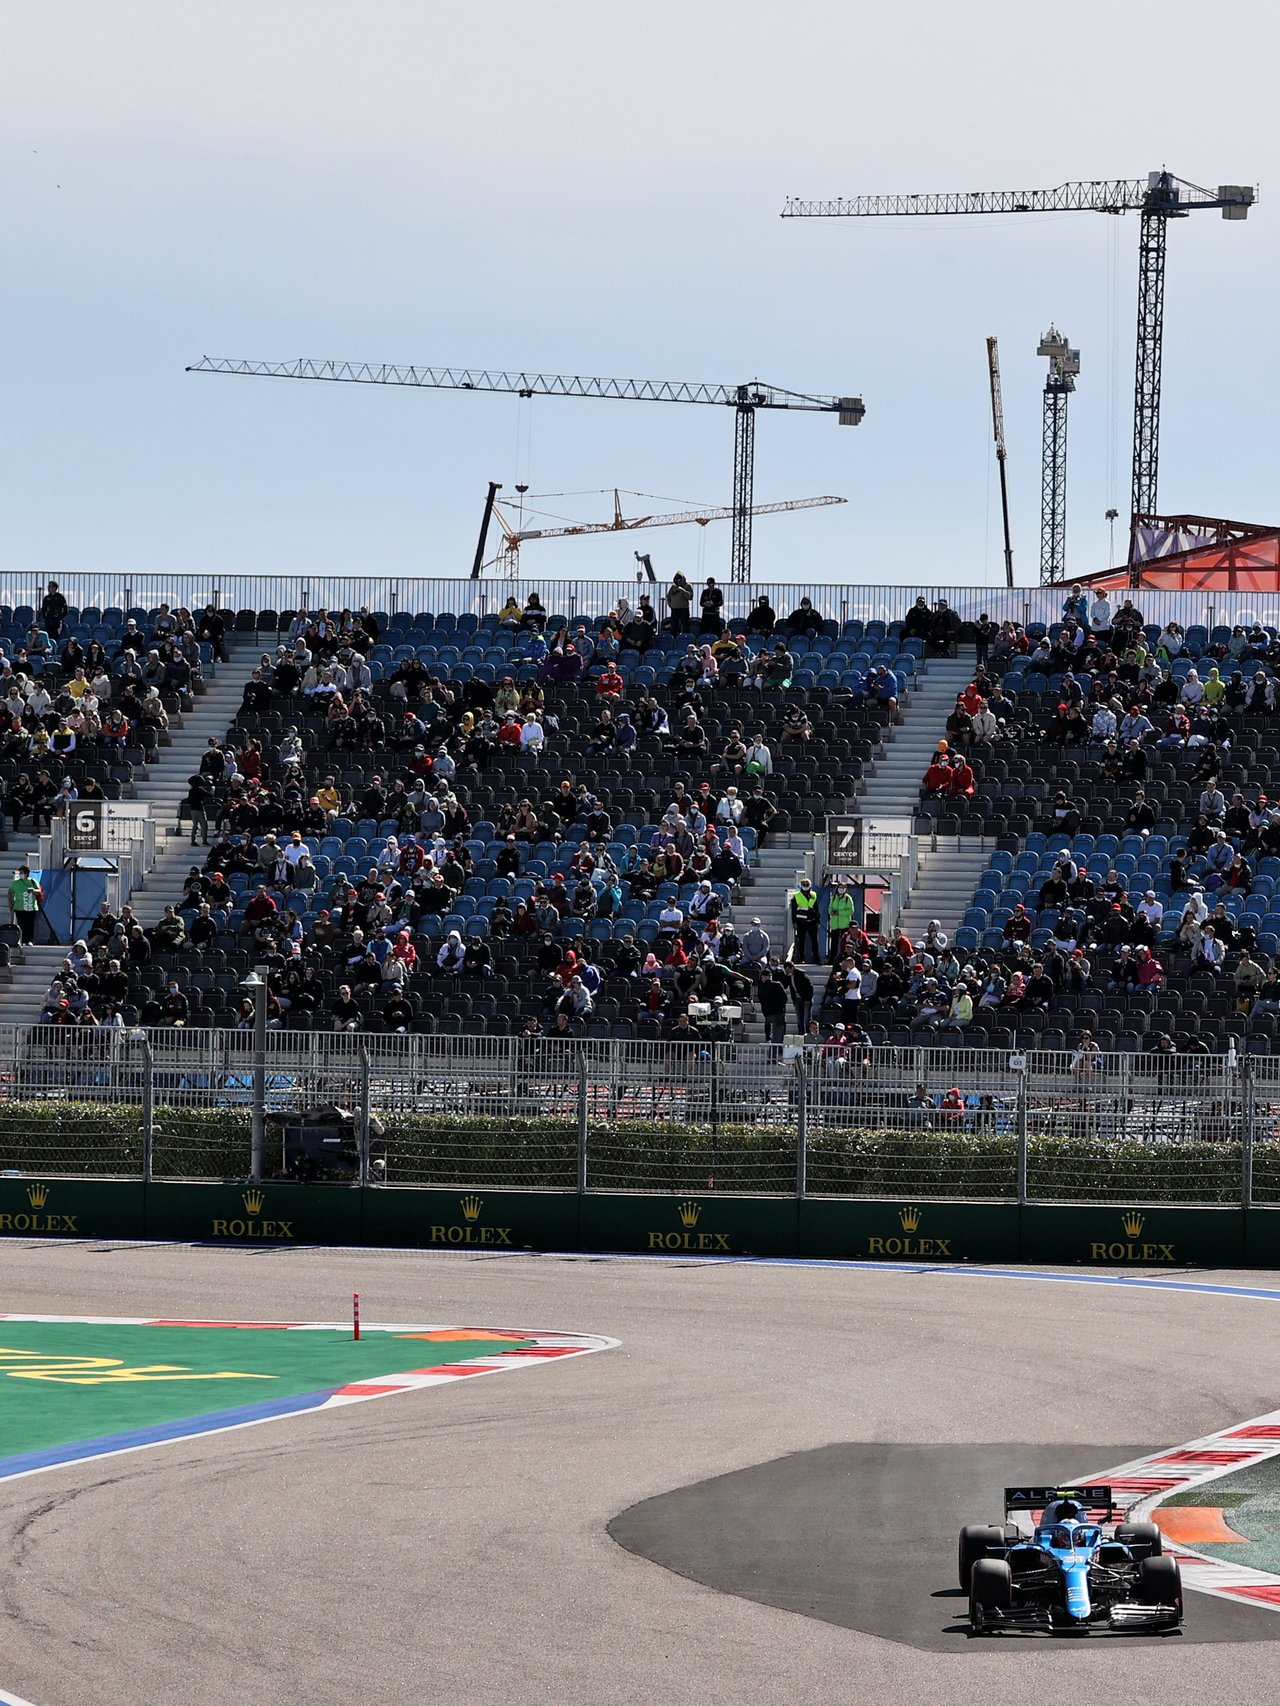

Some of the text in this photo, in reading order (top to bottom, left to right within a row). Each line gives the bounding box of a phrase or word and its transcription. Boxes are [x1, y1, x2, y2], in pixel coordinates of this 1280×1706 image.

[76, 810, 95, 832] 6
[836, 826, 855, 848] 7
[212, 1219, 295, 1237] ROLEX
[430, 1226, 512, 1244] ROLEX
[648, 1232, 731, 1250] ROLEX
[868, 1237, 952, 1256] ROLEX
[1090, 1242, 1176, 1261] ROLEX
[1012, 1489, 1104, 1499] ALPNE
